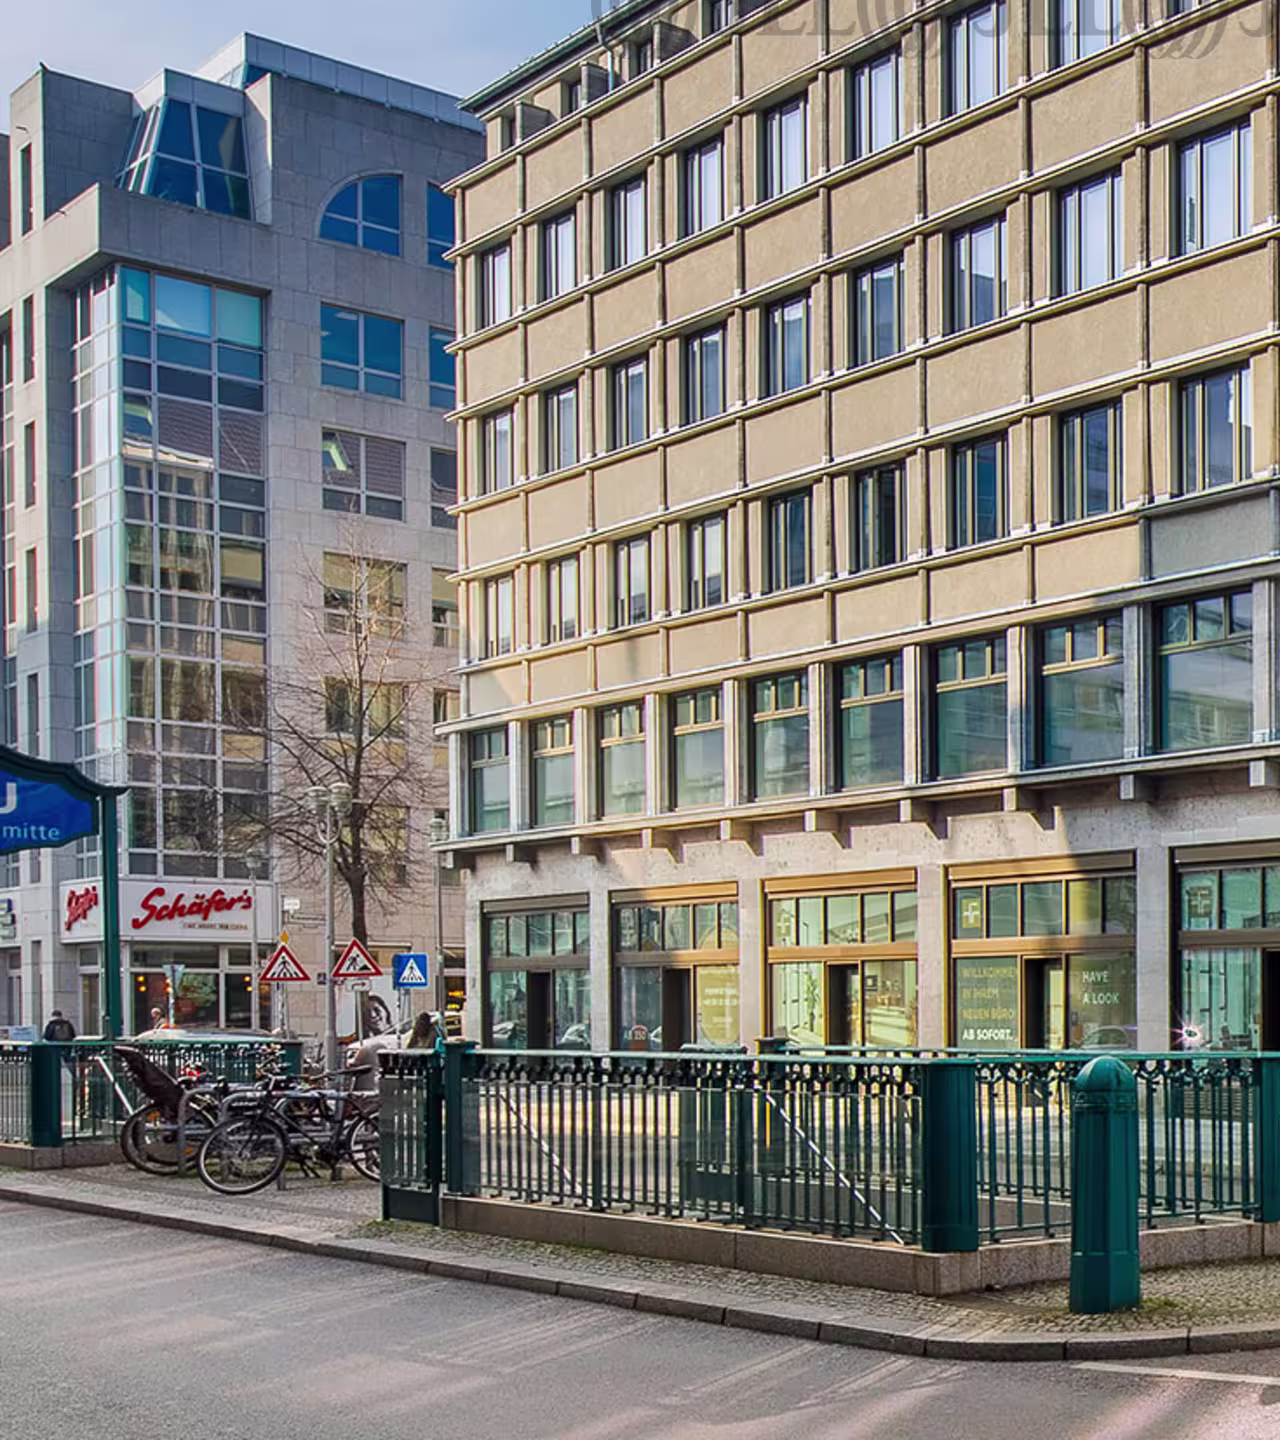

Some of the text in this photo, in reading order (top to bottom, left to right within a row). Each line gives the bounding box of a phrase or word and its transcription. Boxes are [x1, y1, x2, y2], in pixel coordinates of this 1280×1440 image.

[131, 887, 252, 929] Schäfer's
[1082, 971, 1109, 983] HAVE
[1082, 992, 1120, 1005] A LOOK
[962, 1028, 975, 1041] AB
